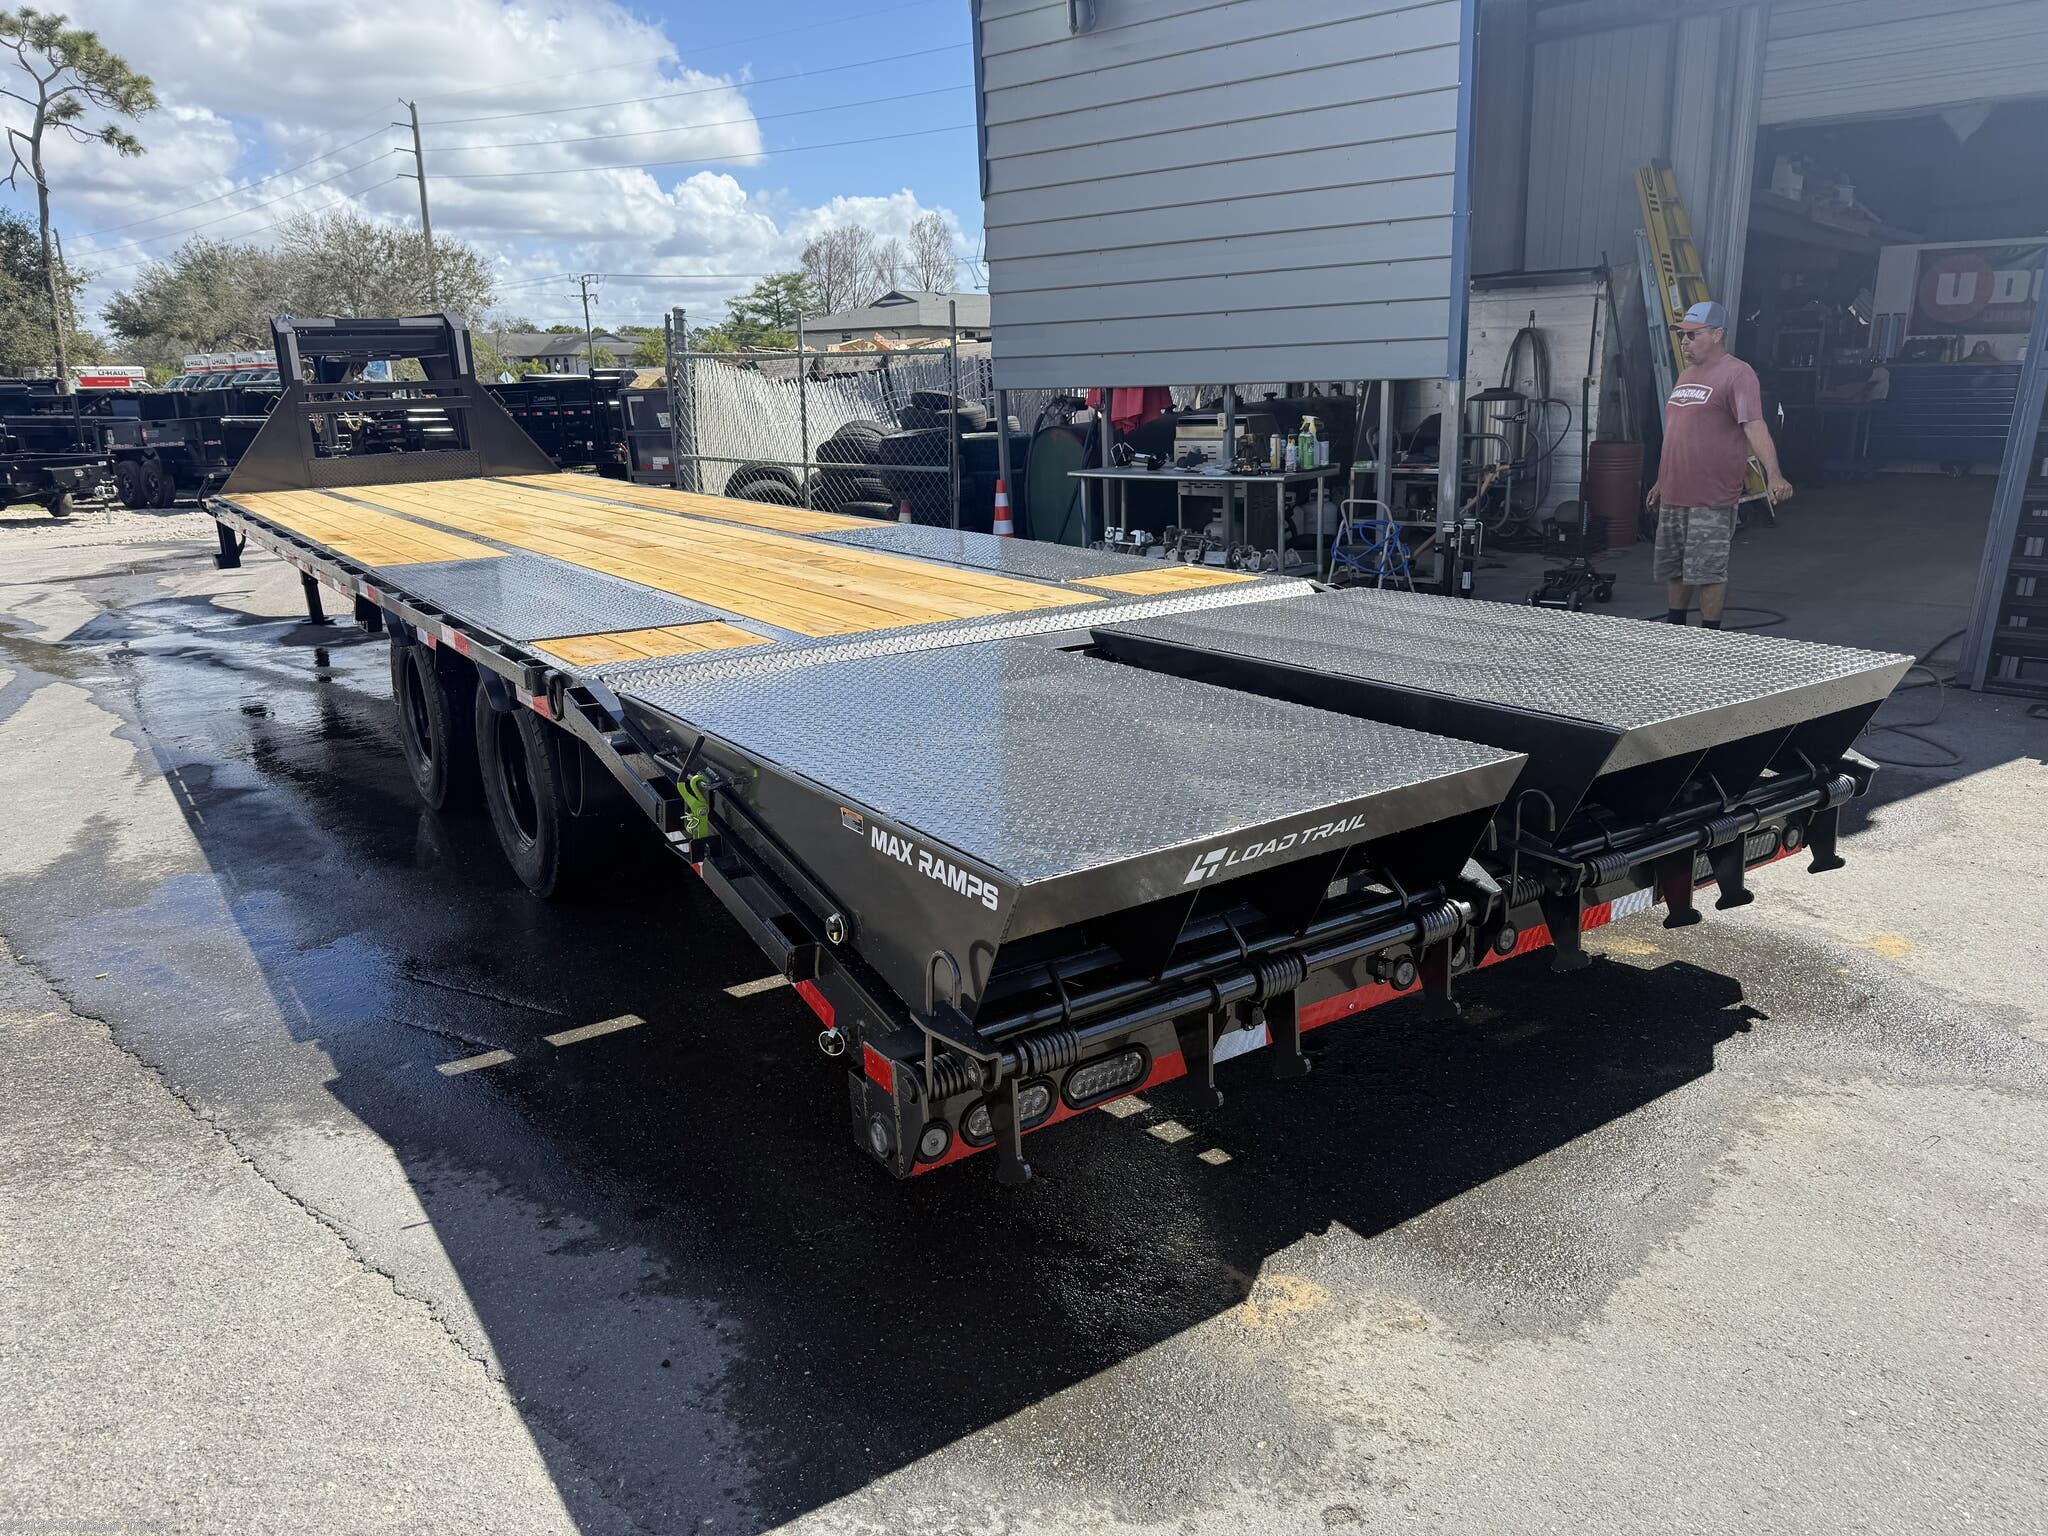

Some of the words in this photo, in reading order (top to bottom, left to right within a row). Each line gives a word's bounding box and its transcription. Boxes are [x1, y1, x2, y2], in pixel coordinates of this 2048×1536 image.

[871, 825, 914, 867] MAX
[918, 849, 999, 912] RAMPS
[1225, 833, 1298, 868] LOAD
[1300, 813, 1366, 846] TRAIL
